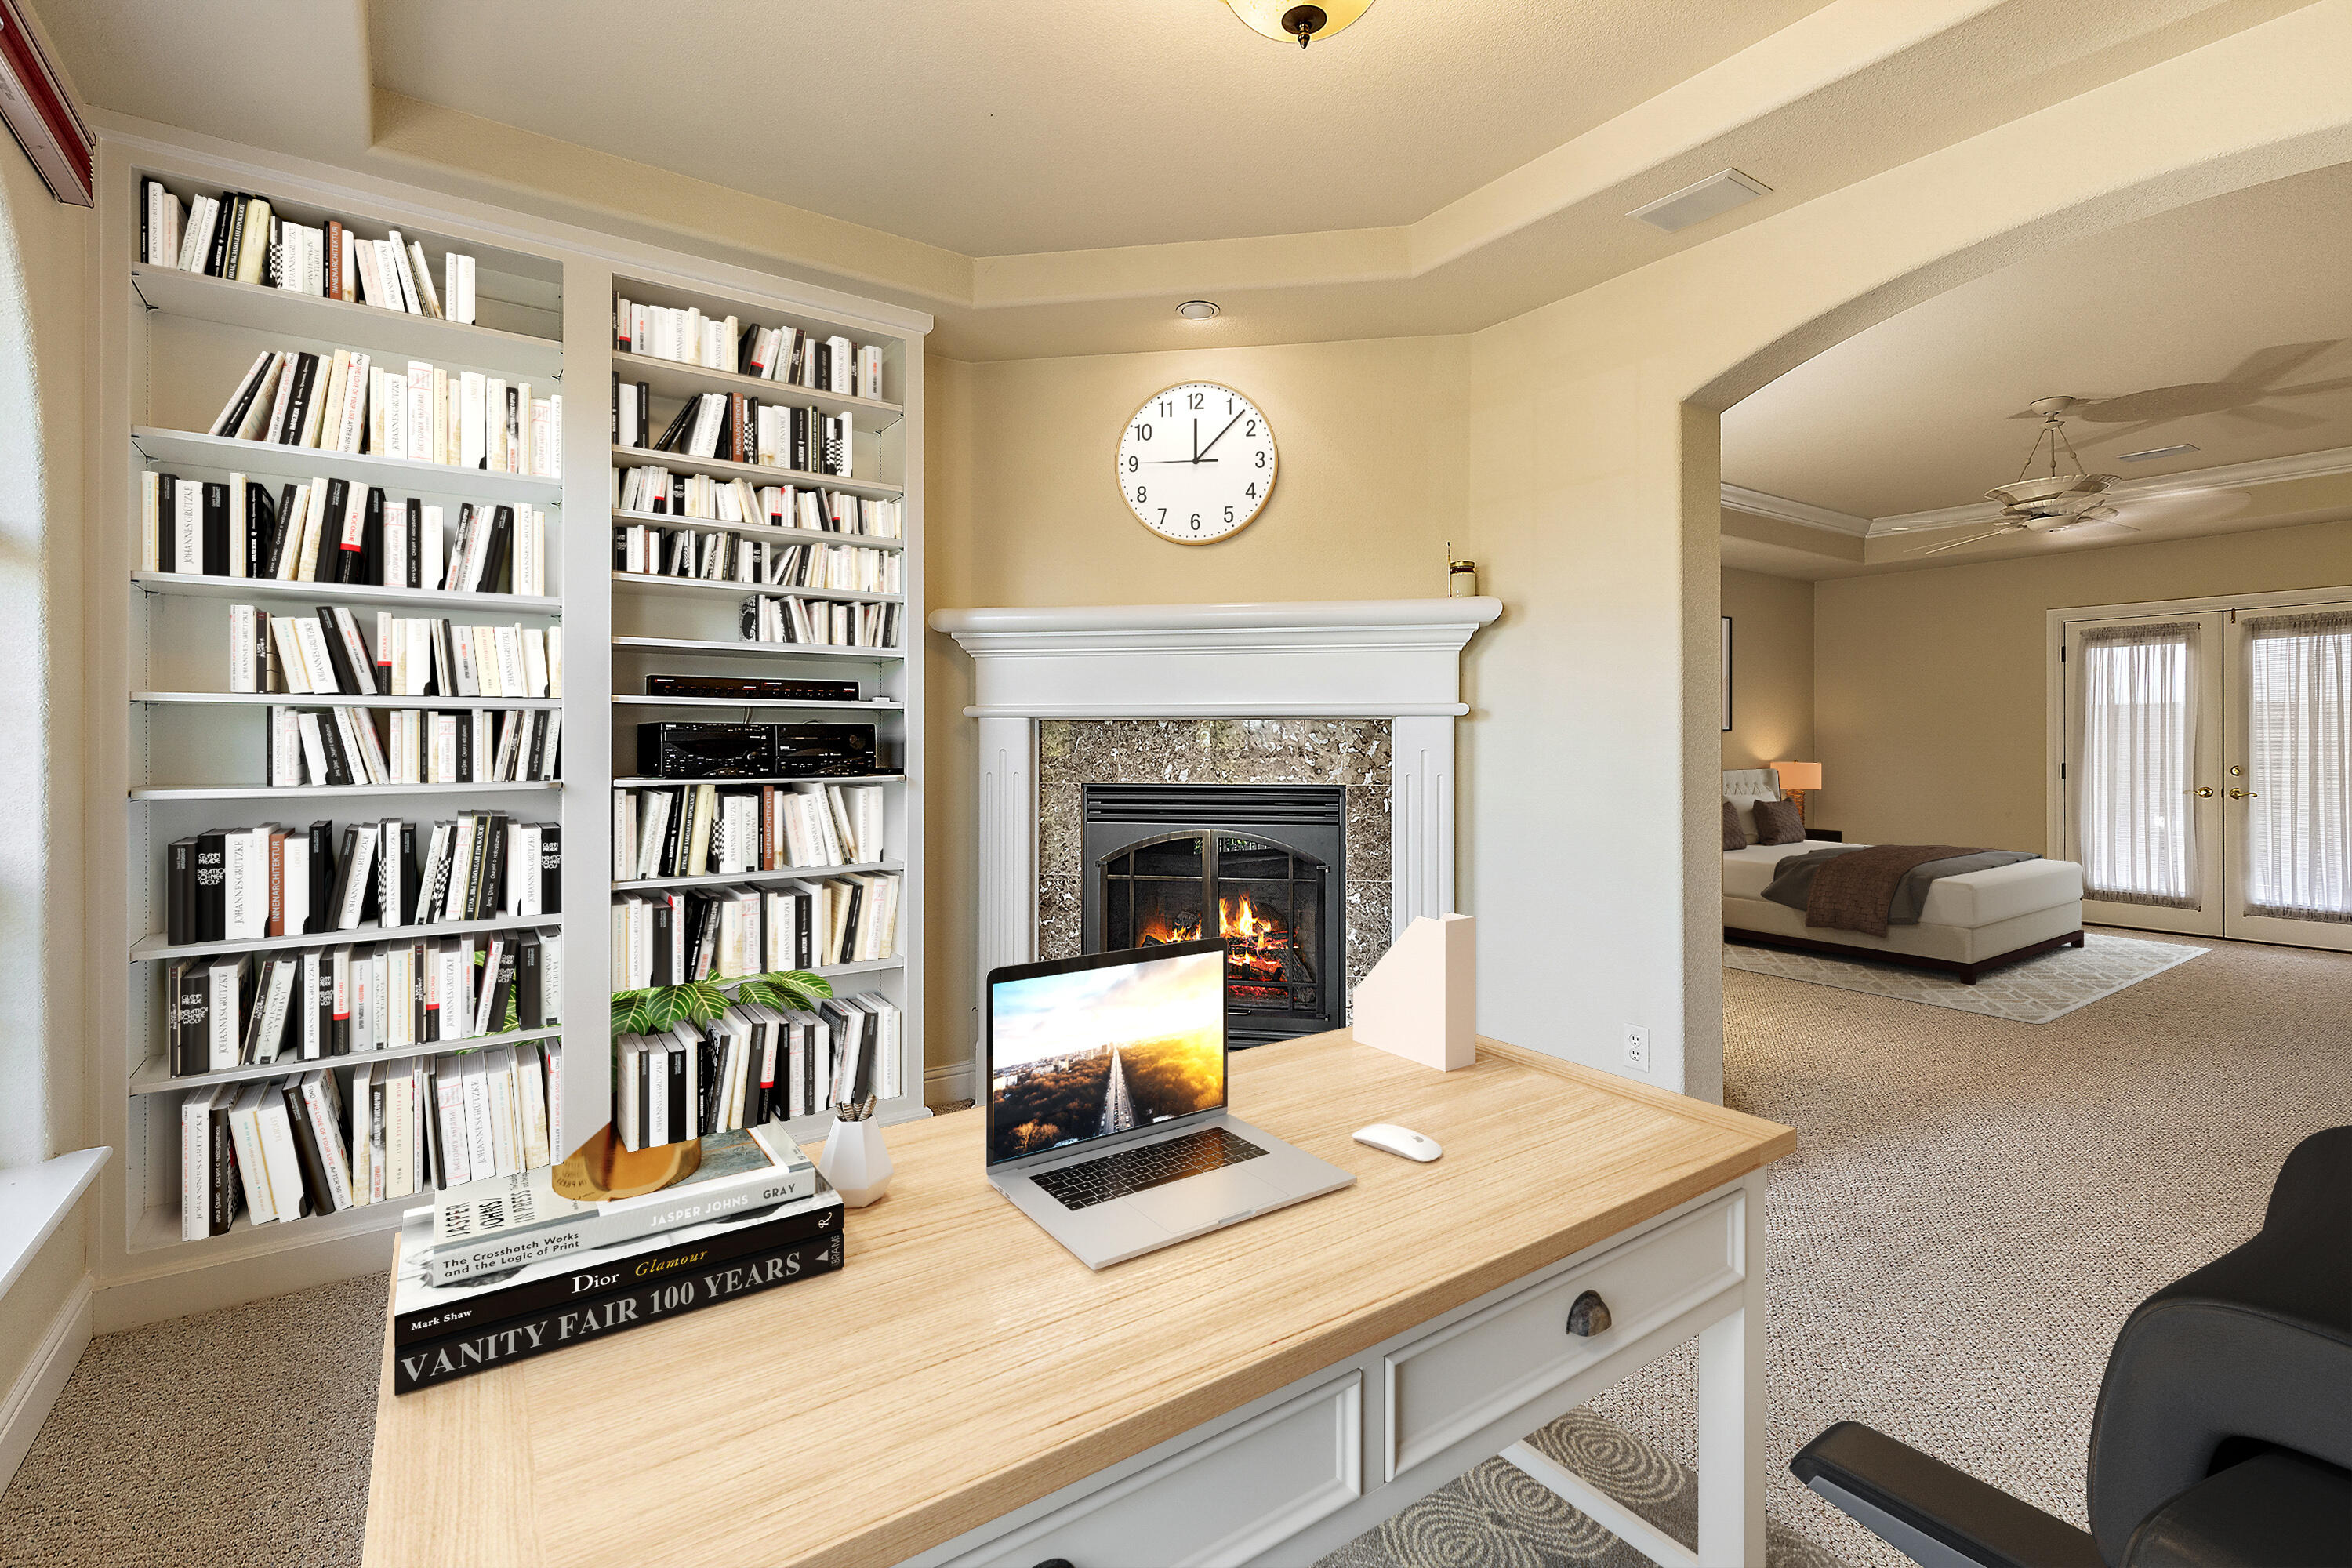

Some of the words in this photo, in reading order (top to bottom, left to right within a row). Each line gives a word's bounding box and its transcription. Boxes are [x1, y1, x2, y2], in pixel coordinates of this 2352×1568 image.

[1159, 401, 1173, 417] 11
[1187, 392, 1204, 410] 12
[1226, 398, 1232, 416] 1
[1135, 423, 1152, 441] 10
[1246, 420, 1256, 437] 2
[1129, 456, 1138, 472] 9
[1254, 452, 1265, 468] 3
[1137, 486, 1147, 503] 8
[1245, 483, 1256, 499] 4
[1157, 508, 1167, 525] 7
[1190, 514, 1201, 530] 6
[1224, 506, 1234, 523] 5
[184, 524, 194, 564] JOHANNES
[475, 825, 485, 855] ПРОКАЗОЙ
[471, 855, 481, 885] ЗАБОЛЕЛИ
[272, 840, 281, 922] INNENARCHITEKTUR
[470, 885, 477, 895] ВЫ
[234, 880, 245, 924] JOHANNES
[219, 1011, 228, 1054] JOHANNES
[315, 1110, 325, 1127] LOVE
[320, 1127, 326, 1136] OF
[321, 1137, 331, 1152] YOUR
[474, 1120, 486, 1163] JOHANNES
[330, 1167, 339, 1185] AFTER
[763, 1183, 796, 1200] GRAY
[511, 1190, 534, 1213] PRESS
[650, 1205, 701, 1228] JASPER
[704, 1193, 748, 1217] JOHNS
[445, 1201, 470, 1238] JASPER
[514, 1212, 535, 1224] IN
[443, 1258, 466, 1269] The
[473, 1242, 539, 1261] Crosshatch
[544, 1232, 579, 1245] Works
[445, 1265, 470, 1277] and
[475, 1257, 495, 1270] the
[501, 1251, 532, 1264] Logic
[537, 1247, 548, 1256] of
[553, 1241, 579, 1253] Print
[635, 1249, 709, 1278] Glamour
[572, 1270, 619, 1294] Dior
[401, 1321, 549, 1383] VANITY
[559, 1298, 638, 1342] FAIR
[649, 1281, 695, 1316] 100
[704, 1251, 801, 1299] YEARS
[411, 1315, 441, 1331] Mark
[444, 1309, 472, 1325] Shaw
